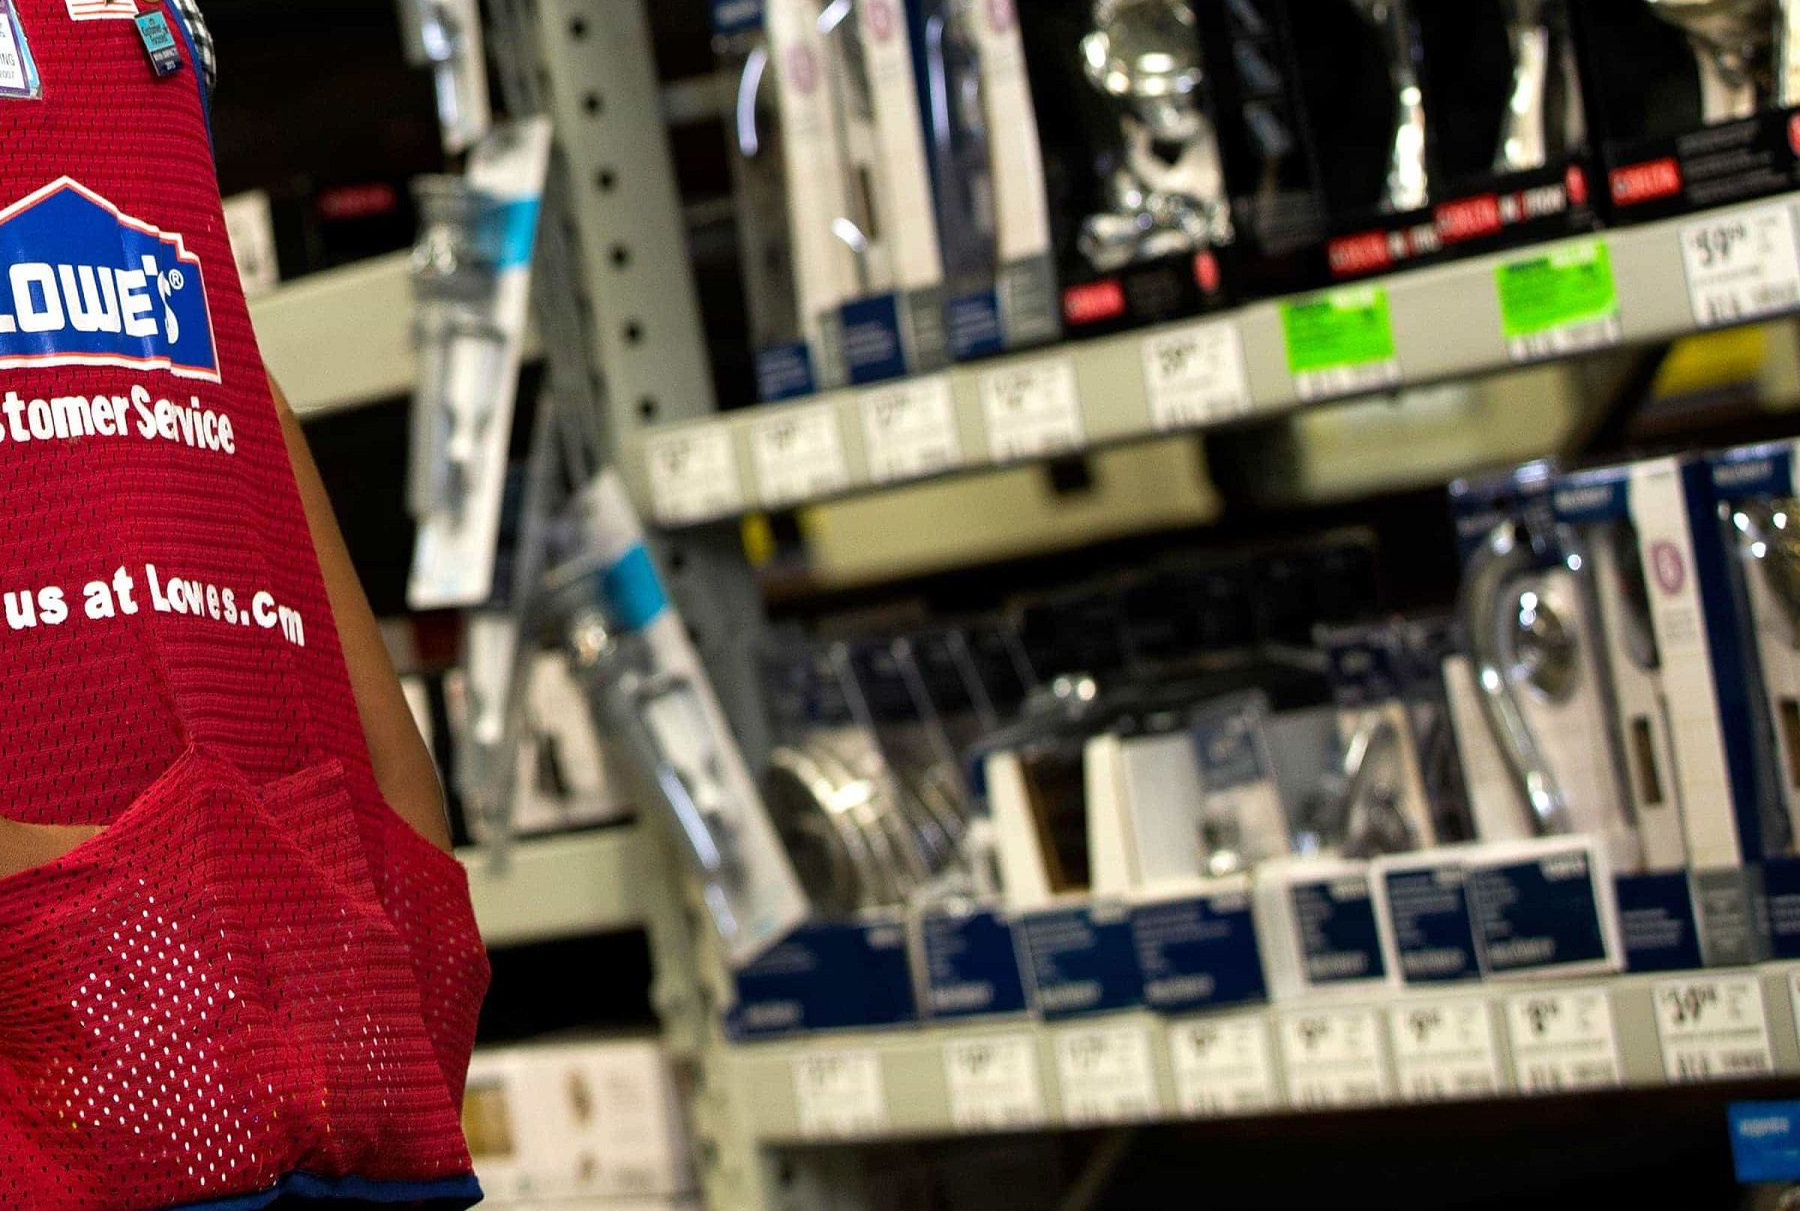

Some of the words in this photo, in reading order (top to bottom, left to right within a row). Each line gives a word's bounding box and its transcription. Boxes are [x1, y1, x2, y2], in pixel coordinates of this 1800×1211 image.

[130, 384, 236, 454] Service
[2, 585, 69, 630] us
[82, 565, 139, 621] at
